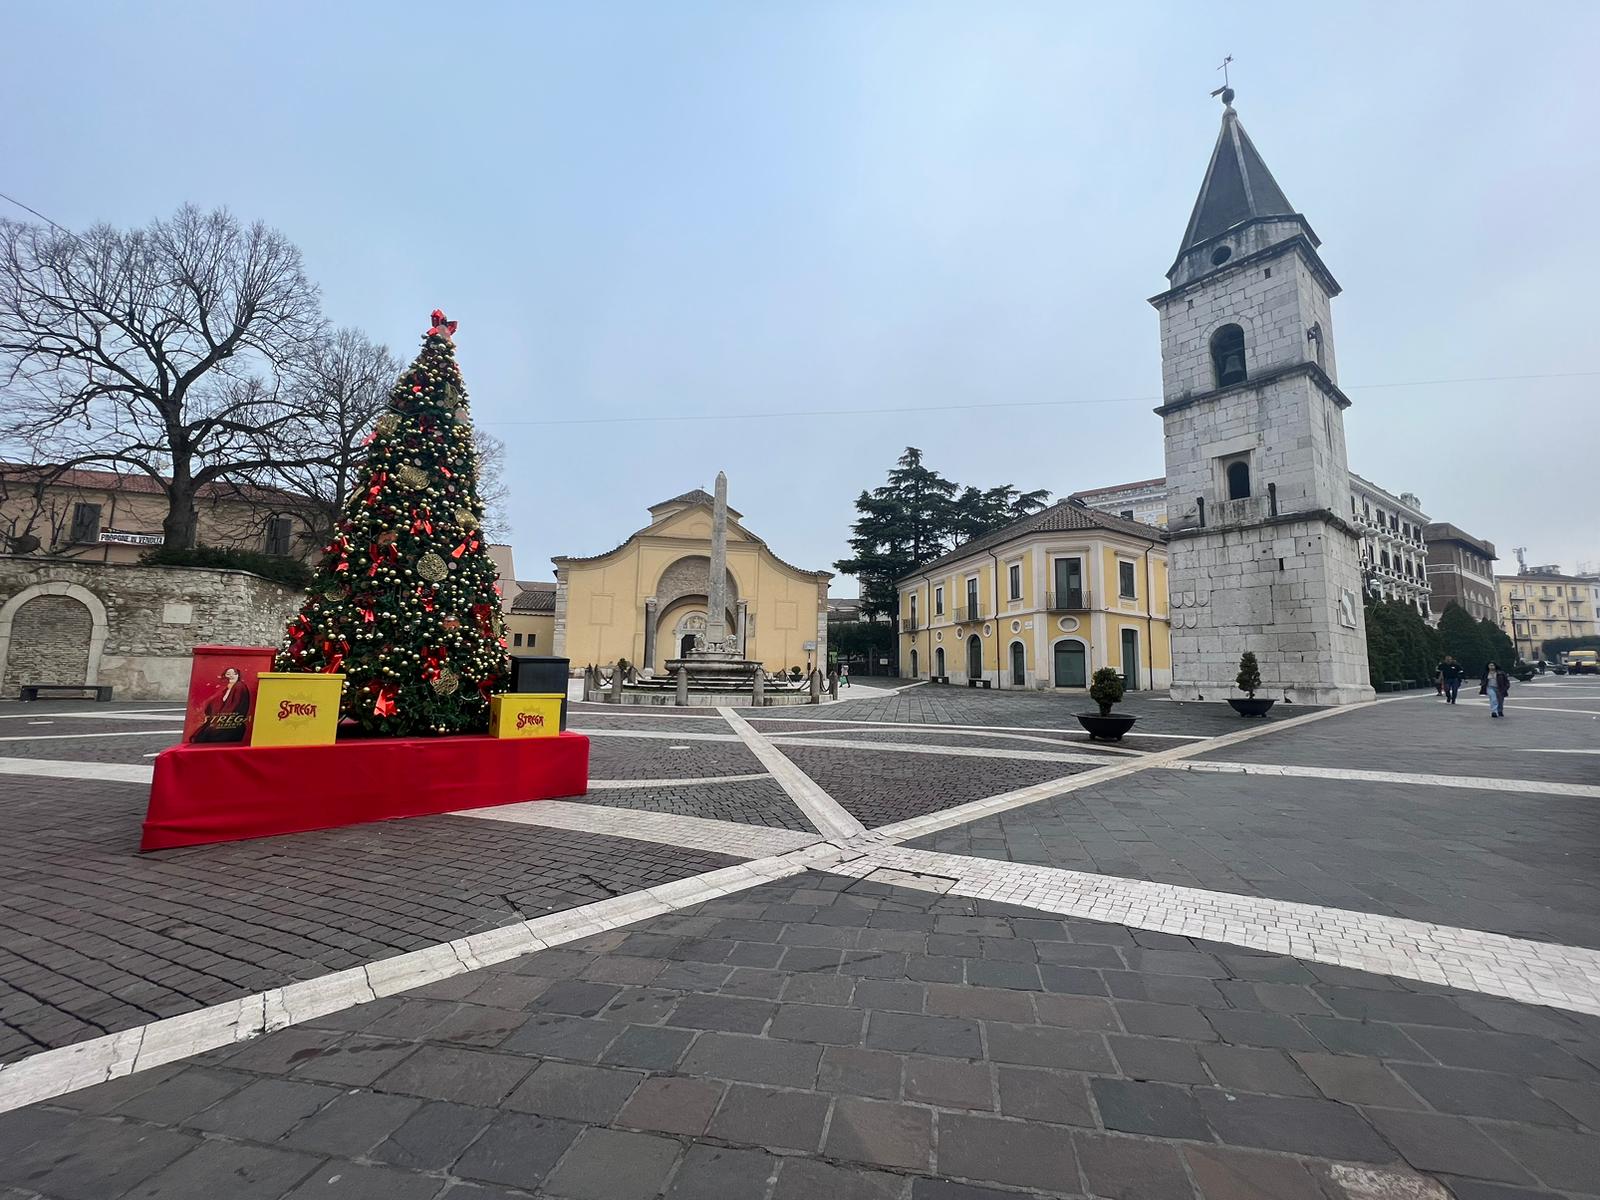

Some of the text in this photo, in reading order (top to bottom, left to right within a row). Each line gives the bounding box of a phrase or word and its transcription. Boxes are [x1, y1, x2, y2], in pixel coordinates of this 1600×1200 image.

[203, 715, 251, 724] STREGA
[278, 700, 317, 721] STREGA
[516, 712, 544, 731] STREGA
